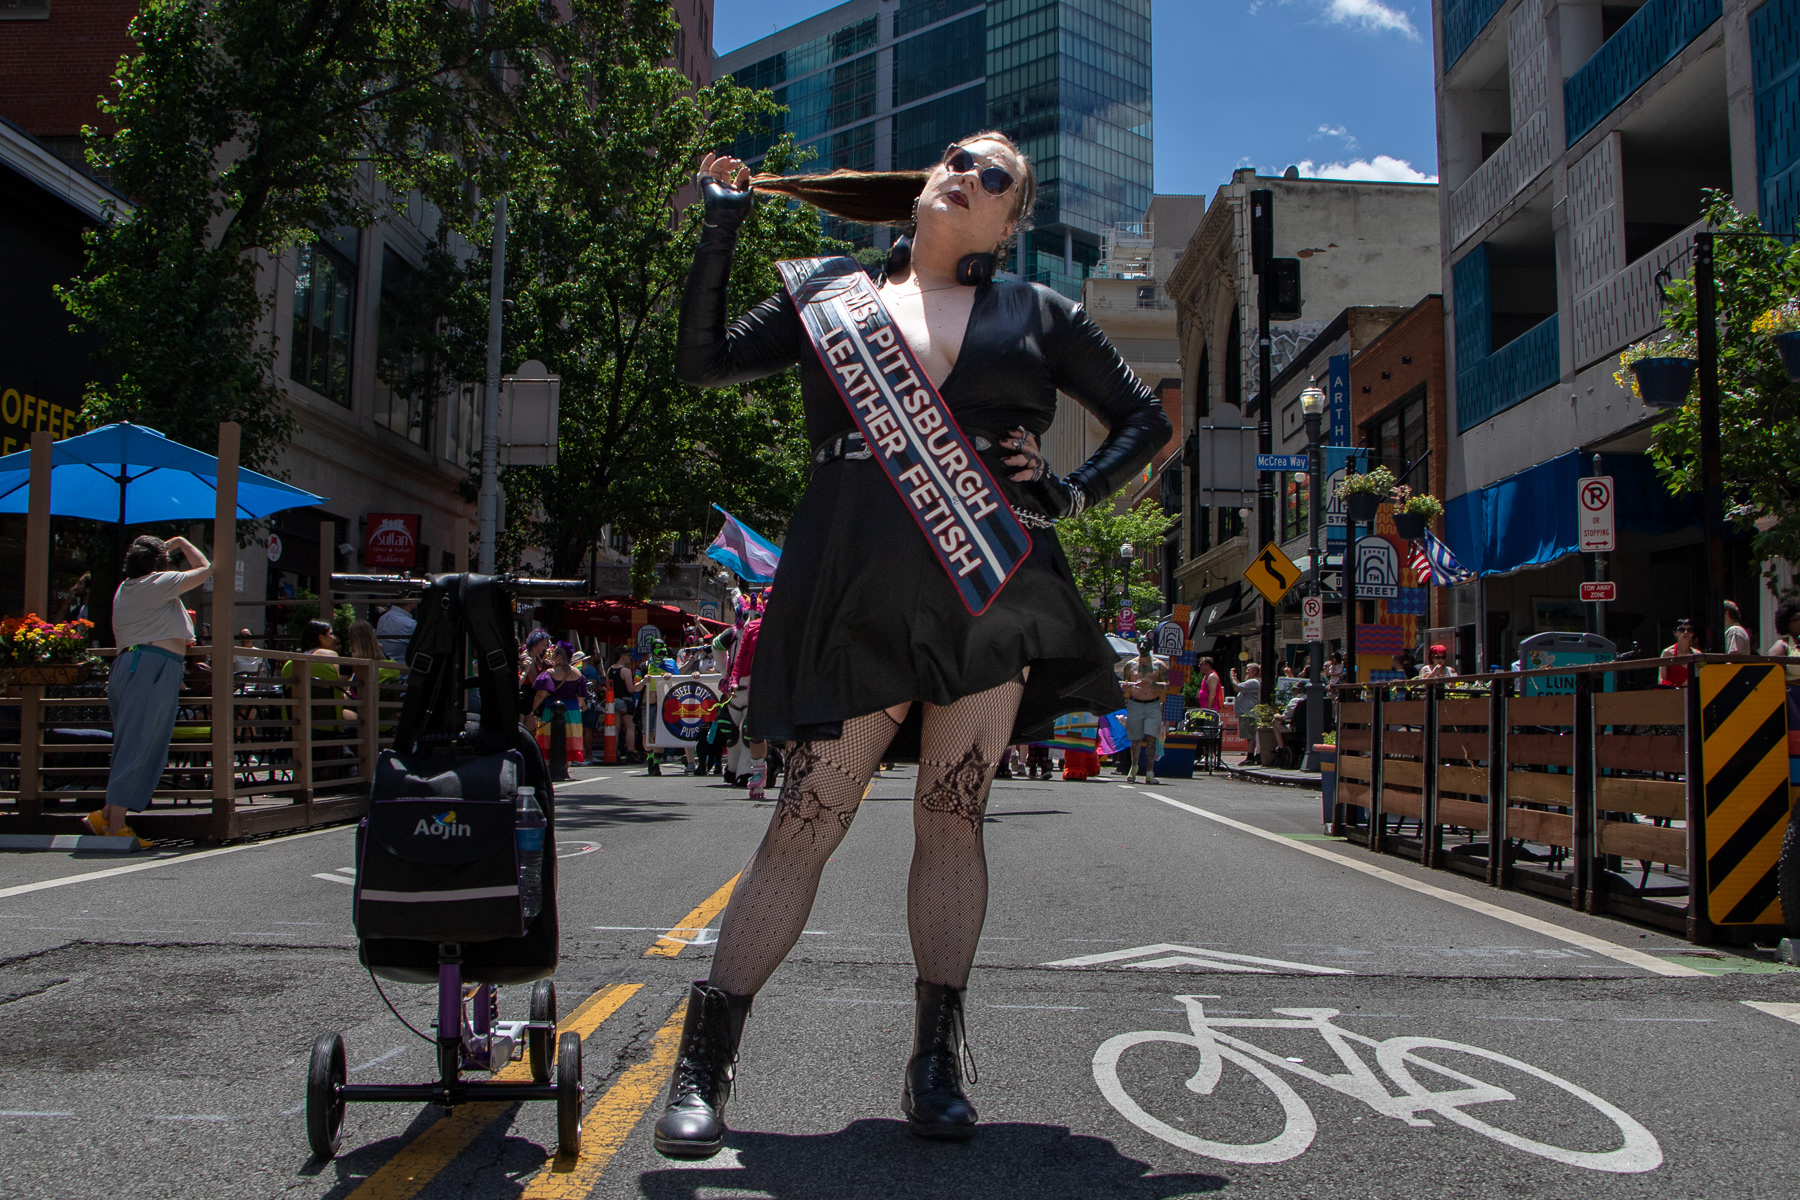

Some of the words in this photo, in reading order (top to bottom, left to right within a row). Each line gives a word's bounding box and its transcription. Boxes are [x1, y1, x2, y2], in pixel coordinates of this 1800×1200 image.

[845, 290, 879, 330] MS.
[865, 326, 998, 520] PITTSBURGH
[0, 387, 76, 440] OFFEE
[818, 327, 907, 460] LEATHER
[898, 462, 983, 578] FETISH
[1258, 456, 1287, 466] McCrea
[1289, 456, 1306, 469] Way
[1592, 516, 1600, 524] OR
[377, 531, 408, 546] Sultan
[1583, 528, 1610, 538] STOPPING
[1546, 676, 1577, 689] LUN
[672, 685, 692, 700] STEEL
[695, 685, 712, 700] CITY
[413, 818, 471, 839] Aojin
